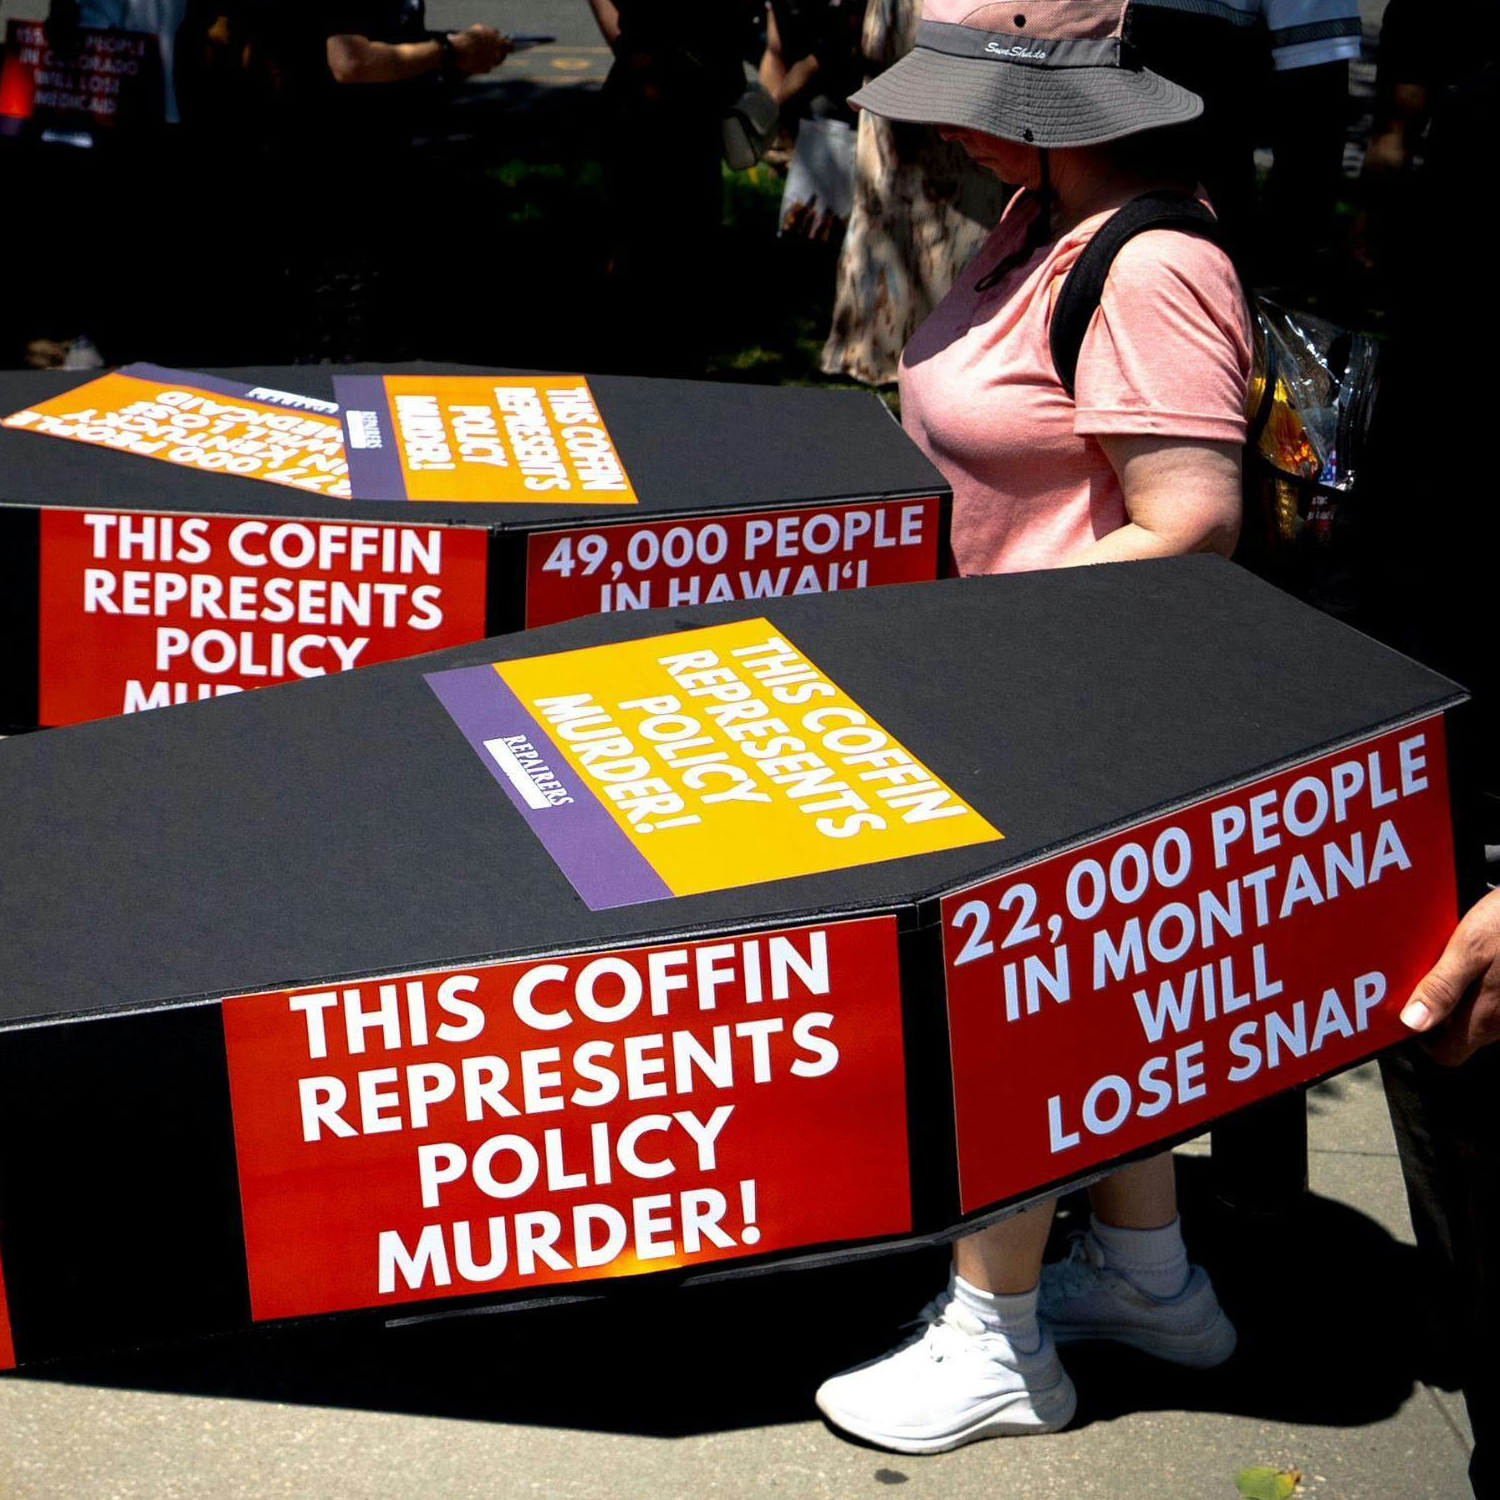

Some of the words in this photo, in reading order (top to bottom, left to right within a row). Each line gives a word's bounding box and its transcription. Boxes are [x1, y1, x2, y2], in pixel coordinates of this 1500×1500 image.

[43, 50, 139, 76] CORADO
[3, 411, 168, 454] PEOPLE
[61, 409, 299, 469] KENTUCKY
[118, 401, 236, 434] LOSE
[156, 391, 344, 443] MEDICAID
[246, 426, 341, 456] WILL
[394, 395, 457, 471] MURDER!
[447, 405, 509, 468] POLICY
[493, 387, 572, 491] REPRESENTS
[545, 387, 600, 424] THIS
[560, 426, 629, 490] COFFIN
[83, 513, 211, 564] THIS
[228, 521, 441, 575] COFFIN
[542, 523, 728, 581] 49,000
[744, 505, 924, 561] PEOPLE
[84, 568, 443, 631] REPRESENTS
[600, 580, 651, 614] IN
[156, 626, 370, 678] POLICY
[534, 693, 702, 834] MURDER!
[618, 694, 773, 805] POLICY
[658, 649, 888, 839] REPRESENTS
[731, 636, 836, 704] THIS
[802, 707, 968, 824] COFFIN
[502, 734, 575, 806] REPAIRERS
[951, 826, 1192, 967] 22,000
[1211, 733, 1428, 869] PEOPLE
[1003, 943, 1071, 1022] IN
[1093, 819, 1412, 991] MONTANA
[288, 974, 486, 1059] THIS
[512, 930, 830, 1031] COFFIN
[1132, 943, 1283, 1044] WILL
[298, 1011, 840, 1142] REPRESENTS
[1047, 1040, 1207, 1154] LOSE
[1227, 971, 1387, 1082] SNAP
[417, 1104, 735, 1209] POLICY
[378, 1179, 761, 1294] MURDER!
